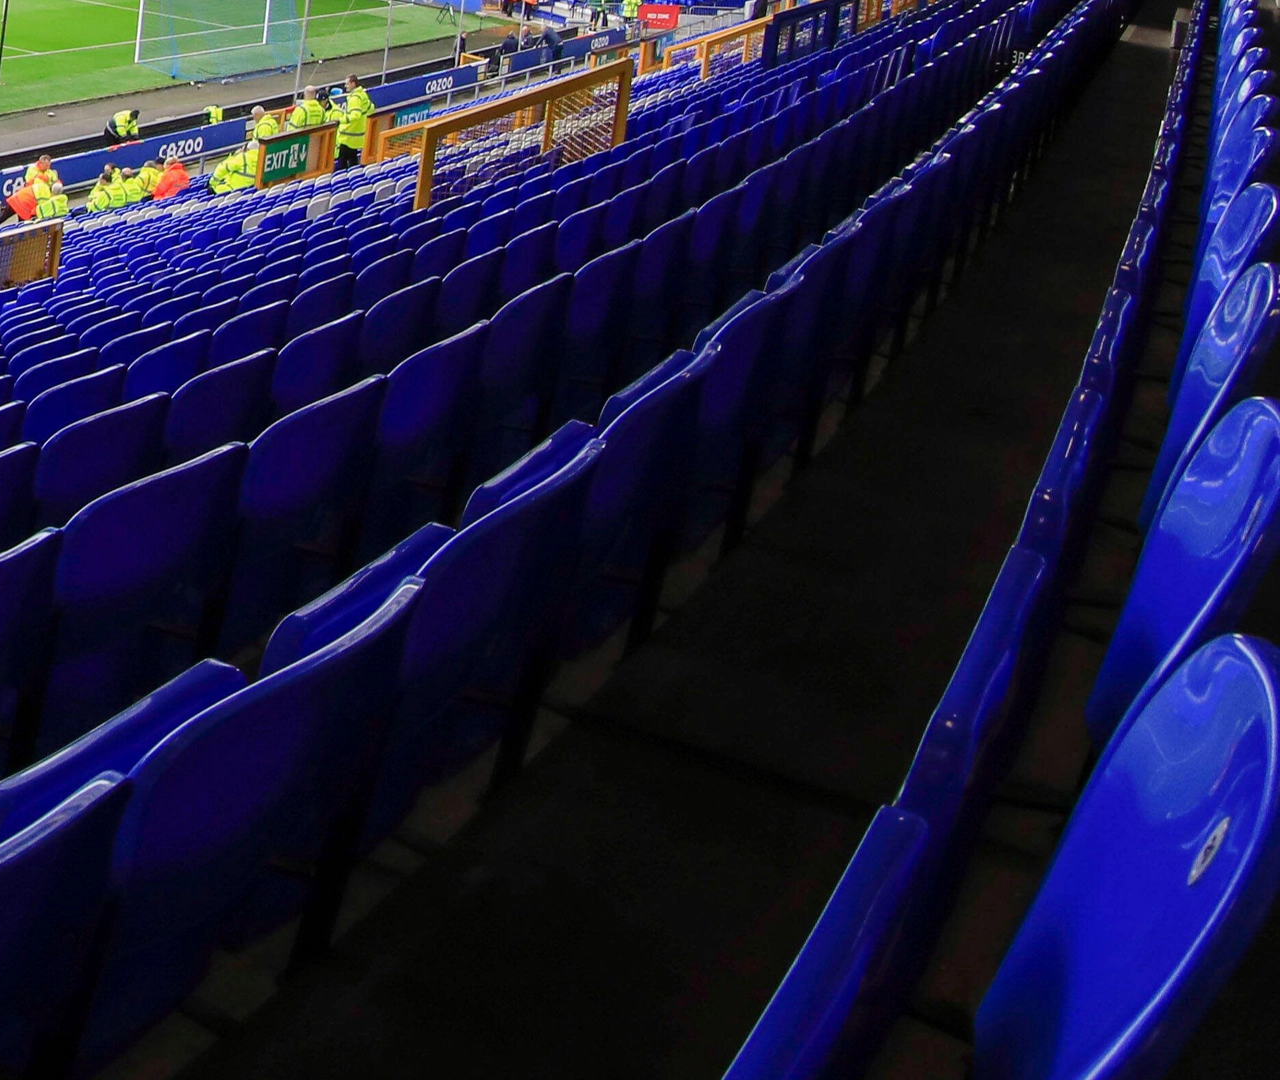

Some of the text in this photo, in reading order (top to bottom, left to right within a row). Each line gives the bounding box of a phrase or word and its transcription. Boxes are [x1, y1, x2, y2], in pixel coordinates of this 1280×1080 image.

[590, 35, 609, 49] CAZOO
[426, 76, 453, 94] CAZOO
[159, 136, 203, 158] CAZOO
[264, 152, 289, 173] EXIT
